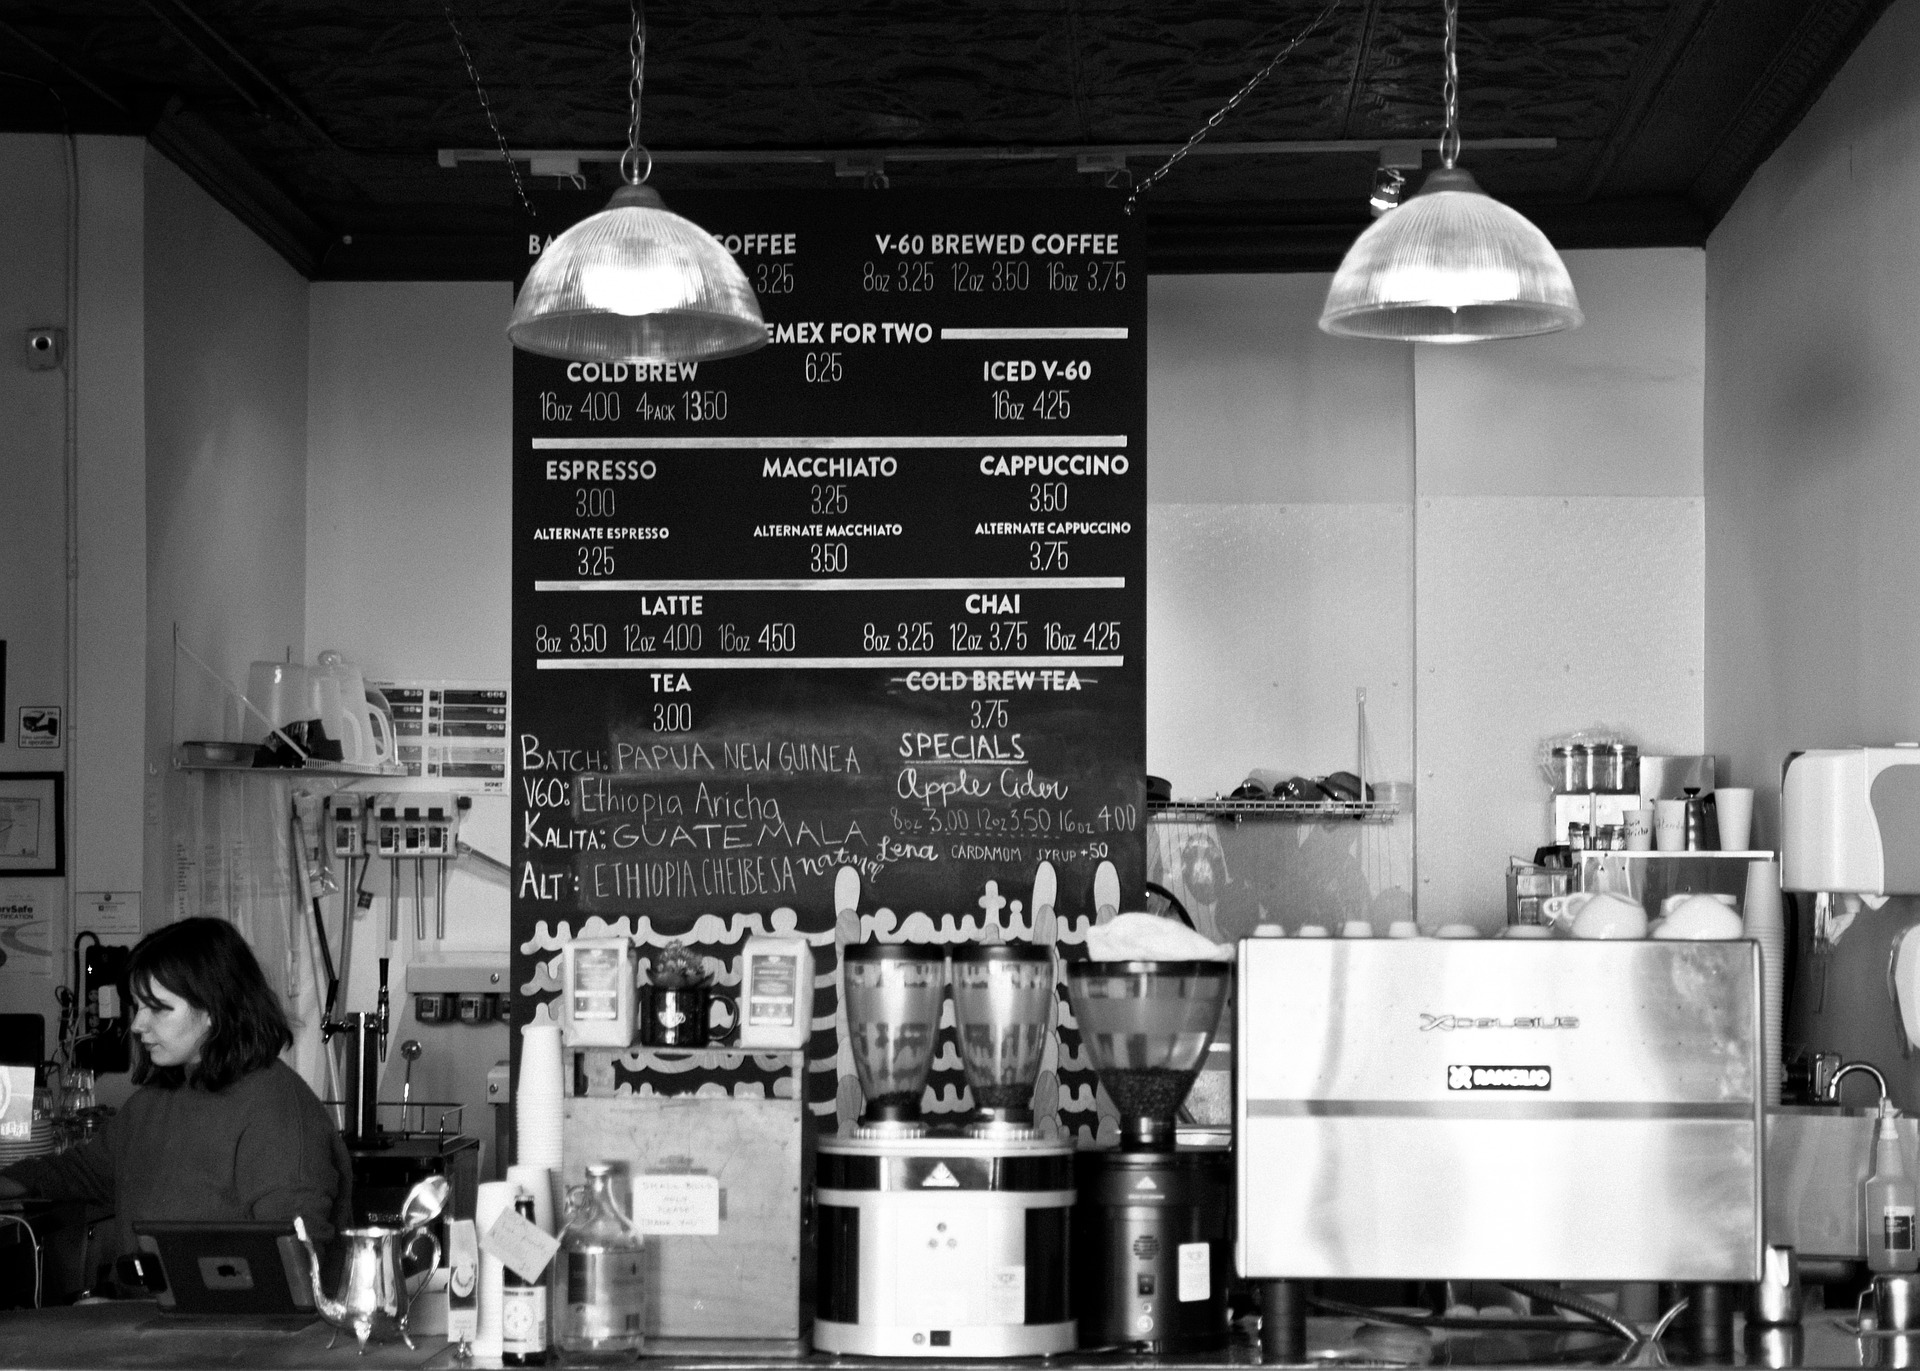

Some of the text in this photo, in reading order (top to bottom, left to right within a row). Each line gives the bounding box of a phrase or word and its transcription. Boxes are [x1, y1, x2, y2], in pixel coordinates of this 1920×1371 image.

[713, 233, 796, 255] OFFEE
[875, 233, 1119, 255] V-60 BREWED COFFEE
[757, 263, 794, 293] 3.25
[863, 261, 1126, 292] 8oz 3.25 12oz 3.50 16oz 3.75
[830, 322, 877, 344] FOR
[881, 322, 933, 344] TWO
[566, 361, 699, 383] COLD BREW
[805, 352, 843, 383] 6.25
[983, 360, 1092, 382] ICED V-60
[539, 391, 572, 422] 16oz
[580, 391, 621, 422] 4.00
[682, 390, 728, 421] 13.50
[991, 390, 1071, 420] 16oz 4.25
[546, 460, 657, 481] ESPRESSO
[762, 456, 898, 478] MACCHIATO
[979, 455, 1129, 476] CAPPUCCINO
[576, 488, 615, 518] 3.00
[811, 484, 848, 515] 3.25
[1030, 482, 1068, 512] 3.50
[534, 527, 670, 540] ALTERNATE ESPRESSO
[753, 524, 903, 537] ALTERNATE MACCHIATO
[975, 522, 1131, 535] ALTERNATE CAPPUCCINO
[578, 546, 615, 576] 3.25
[811, 543, 848, 573] 3.50
[1030, 541, 1069, 571] 3.75
[641, 596, 703, 616] LATTE
[965, 594, 1021, 615] CHAI
[536, 623, 796, 652] 8oz 3.50 12oz 4.00 16oz 4.50
[863, 621, 1121, 651] 8oz 3.25 12oz 3.75 16oz 4.25
[650, 673, 692, 693] TEA
[906, 671, 1082, 691] COLD BREW TEA
[653, 703, 692, 732] 3.00
[970, 700, 1009, 729] 3.75
[618, 742, 715, 770] PAPUA
[724, 741, 771, 771] NEW
[779, 741, 861, 773] GUINEA
[899, 733, 1025, 759] SPECIALS
[580, 777, 683, 825] Ethiopia
[695, 781, 782, 824] Aricha
[897, 768, 1069, 807] Apple Cider
[922, 808, 969, 832] 3.00
[1010, 808, 1051, 832] 3.50
[1098, 804, 1136, 832] 4.00
[613, 820, 868, 849] GUATEMALA
[951, 845, 1022, 862] CARDAMOM
[1036, 848, 1077, 861] SYRUP
[594, 860, 697, 898] ETHIOPIA
